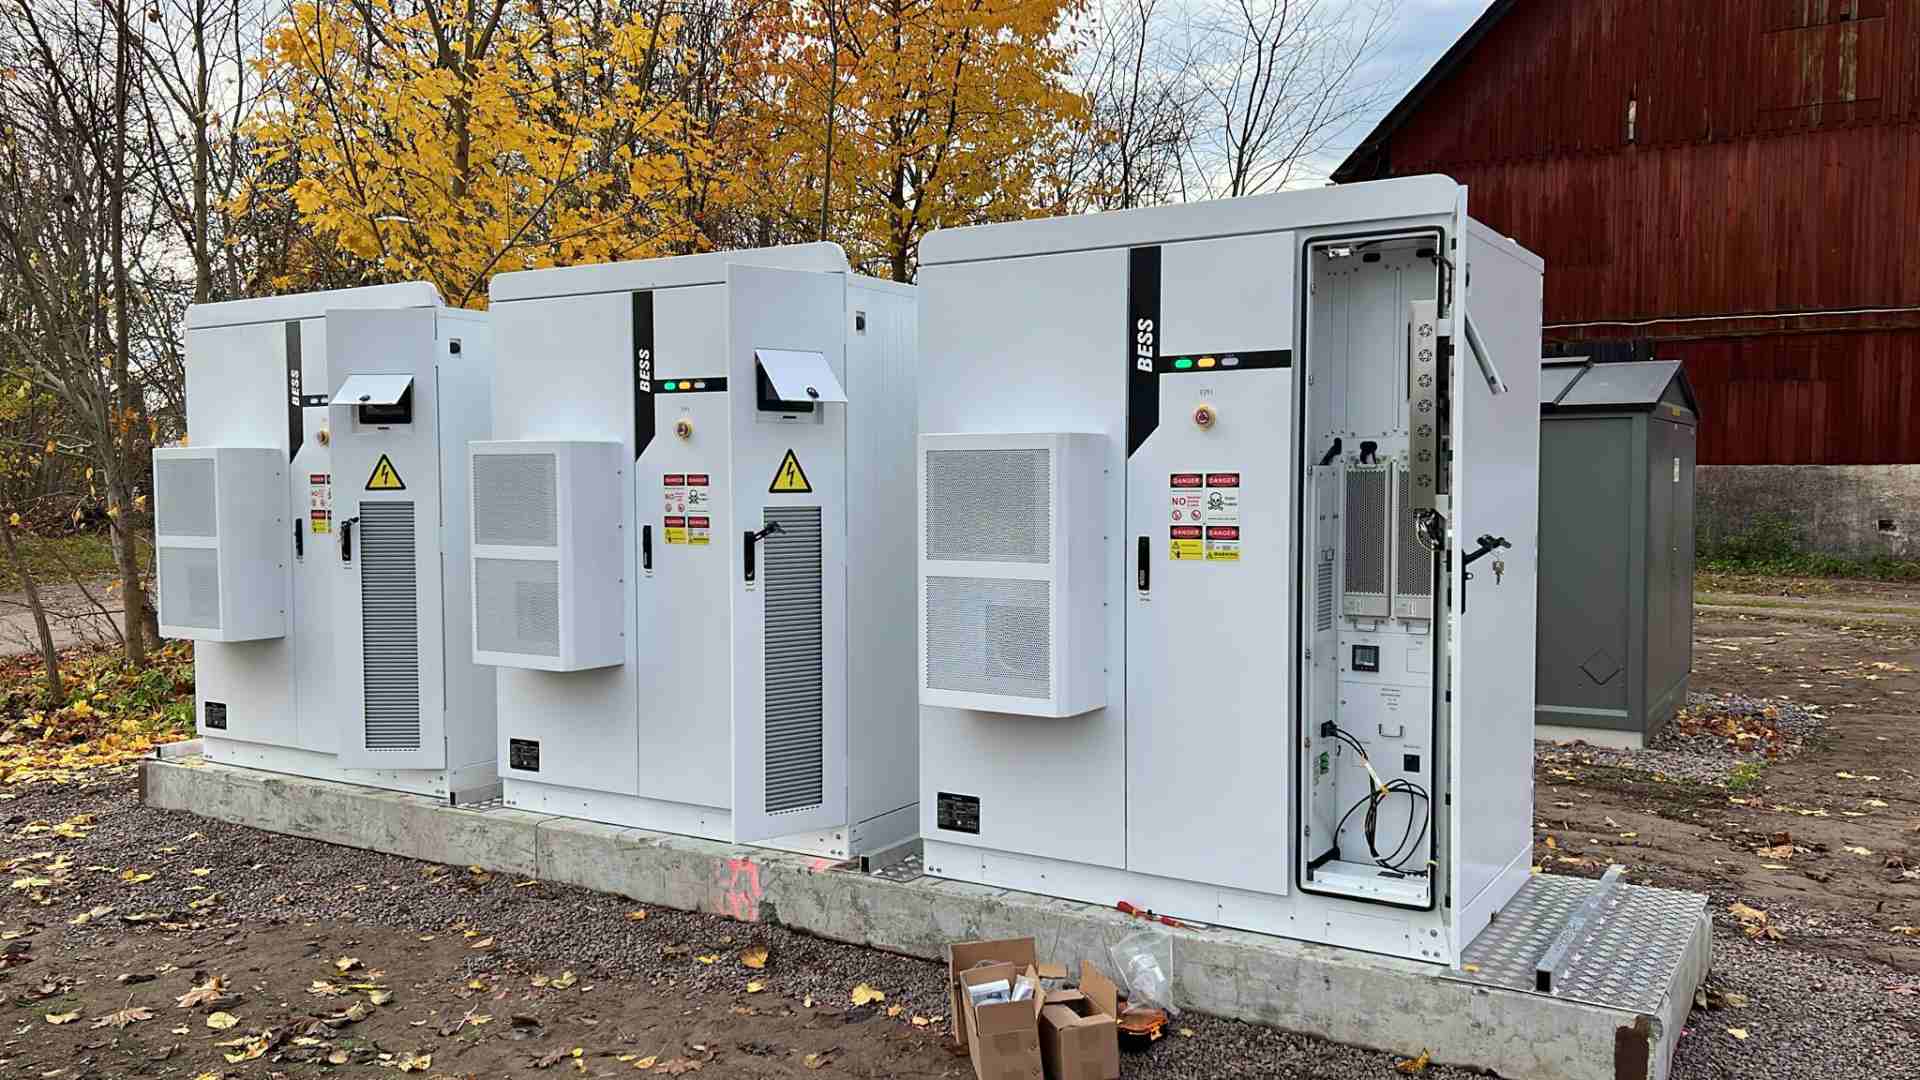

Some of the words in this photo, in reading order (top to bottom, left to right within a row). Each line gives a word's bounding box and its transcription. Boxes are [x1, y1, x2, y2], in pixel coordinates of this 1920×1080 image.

[1137, 318, 1153, 373] BESS
[291, 369, 300, 406] BESS
[639, 349, 650, 392] BESS
[1172, 496, 1186, 506] NO
